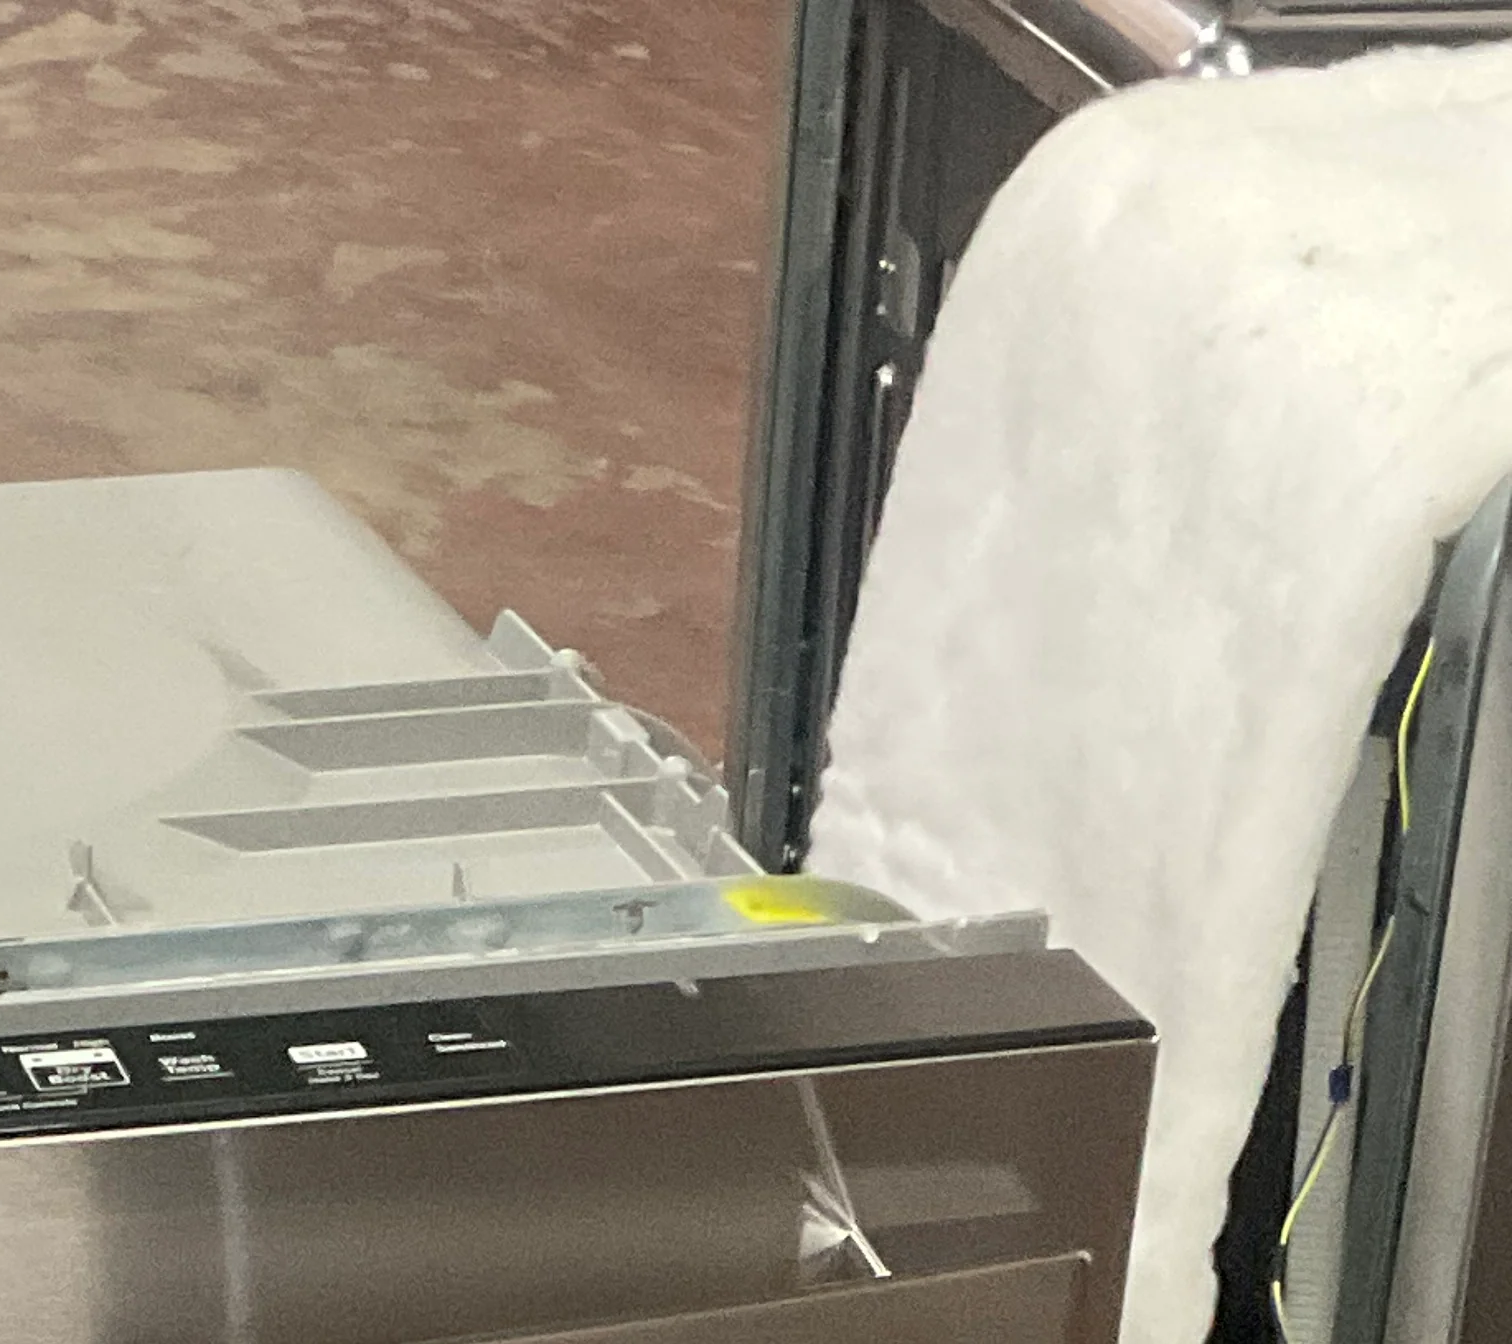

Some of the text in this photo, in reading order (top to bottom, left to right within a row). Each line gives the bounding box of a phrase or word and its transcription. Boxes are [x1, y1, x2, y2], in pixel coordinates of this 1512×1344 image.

[297, 1046, 356, 1060] Start
[157, 1054, 216, 1066] Wash
[55, 1065, 91, 1077] Dry
[166, 1063, 221, 1075] Temp
[48, 1071, 111, 1085] Boost
